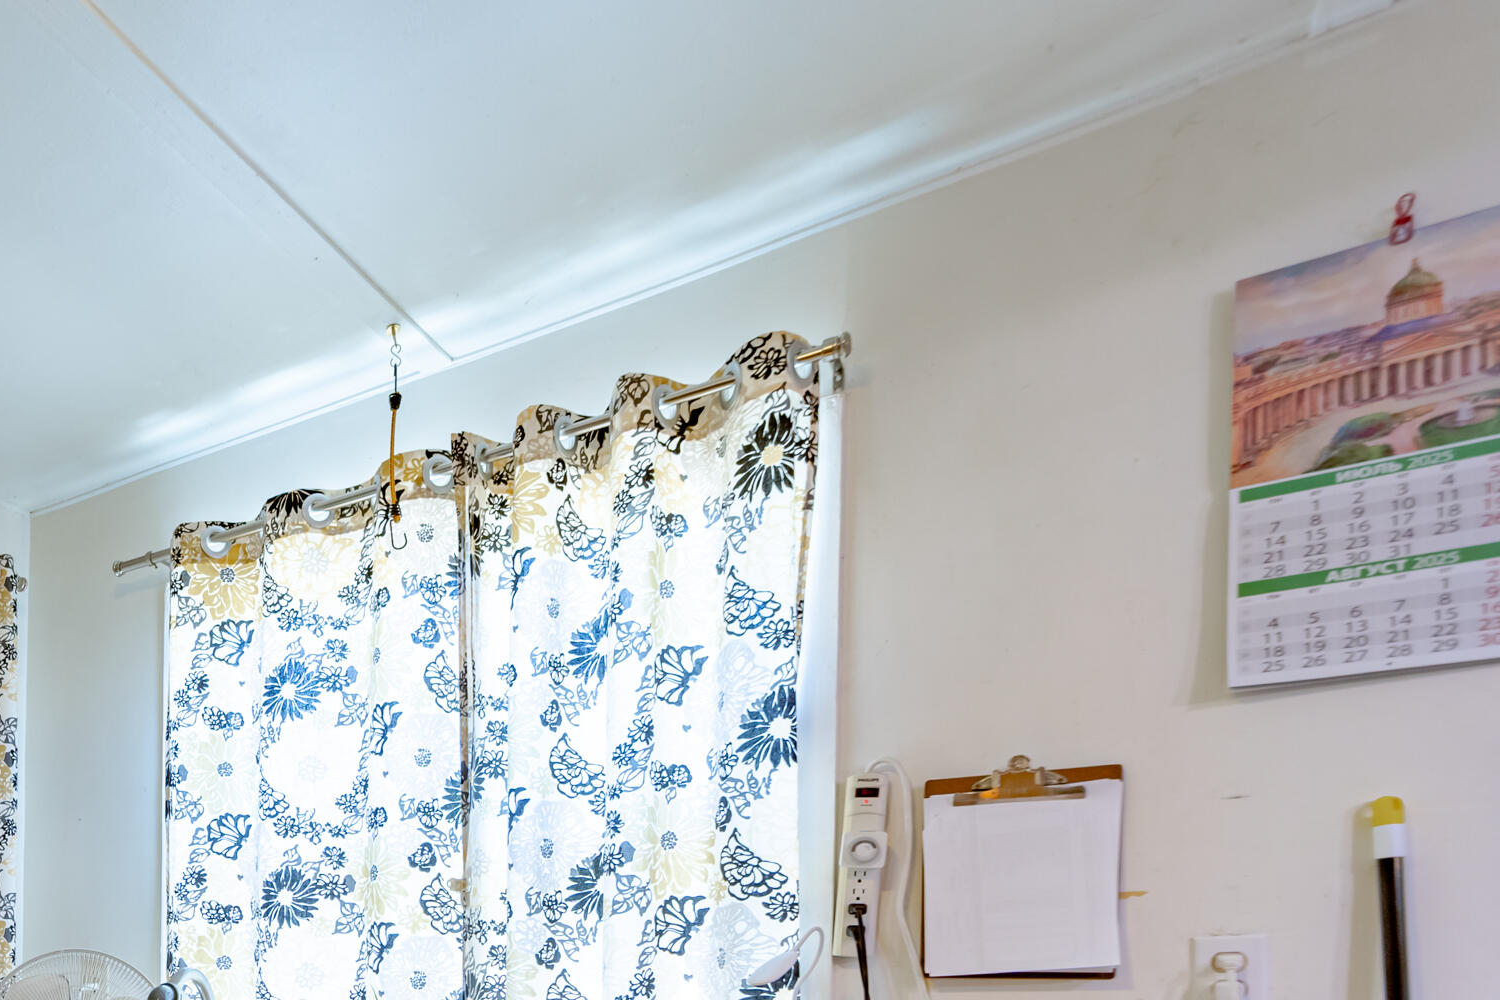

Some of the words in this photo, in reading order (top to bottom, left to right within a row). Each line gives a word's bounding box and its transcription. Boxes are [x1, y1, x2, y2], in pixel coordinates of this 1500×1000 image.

[1334, 461, 1403, 483] ИЮЛЬ
[1408, 449, 1455, 469] 2025
[1351, 491, 1364, 504] 2
[1397, 482, 1409, 496] 3
[1441, 473, 1455, 485] 4
[1264, 535, 1286, 548] 14
[1305, 527, 1328, 542] 15
[1347, 520, 1372, 534] 16
[1391, 512, 1415, 526] 17
[1436, 504, 1462, 519] 18
[1269, 520, 1281, 533] 7
[1309, 514, 1322, 527] 8
[1351, 505, 1365, 519] 9
[1391, 496, 1417, 511] 10
[1436, 489, 1459, 503] 11
[1263, 550, 1284, 564] 21
[1303, 542, 1328, 557] 22
[1345, 535, 1371, 550] 23
[1388, 527, 1414, 543] 24
[1433, 520, 1461, 535] 25
[1263, 564, 1286, 579] 28
[1303, 557, 1328, 572] 29
[1324, 558, 1407, 583] АВГУСТ
[1411, 550, 1461, 571] 2025
[1267, 616, 1279, 627] 4
[1308, 610, 1321, 625] 5
[1349, 605, 1363, 618] 6
[1393, 599, 1406, 612] 7
[1437, 592, 1452, 606] 8
[1485, 584, 1500, 599] 9
[1263, 631, 1283, 644] 11
[1304, 625, 1326, 640] 12
[1344, 619, 1369, 634] 13
[1388, 614, 1412, 627] 14
[1434, 607, 1458, 622] 15
[1264, 645, 1286, 658] 18
[1304, 639, 1327, 654] 19
[1343, 634, 1370, 649] 20
[1386, 629, 1410, 643] 21
[1431, 622, 1458, 637] 22
[1261, 660, 1286, 673] 25
[1301, 654, 1327, 669] 26
[1342, 649, 1369, 663] 27
[1386, 644, 1414, 659] 28
[1430, 639, 1458, 653] 29
